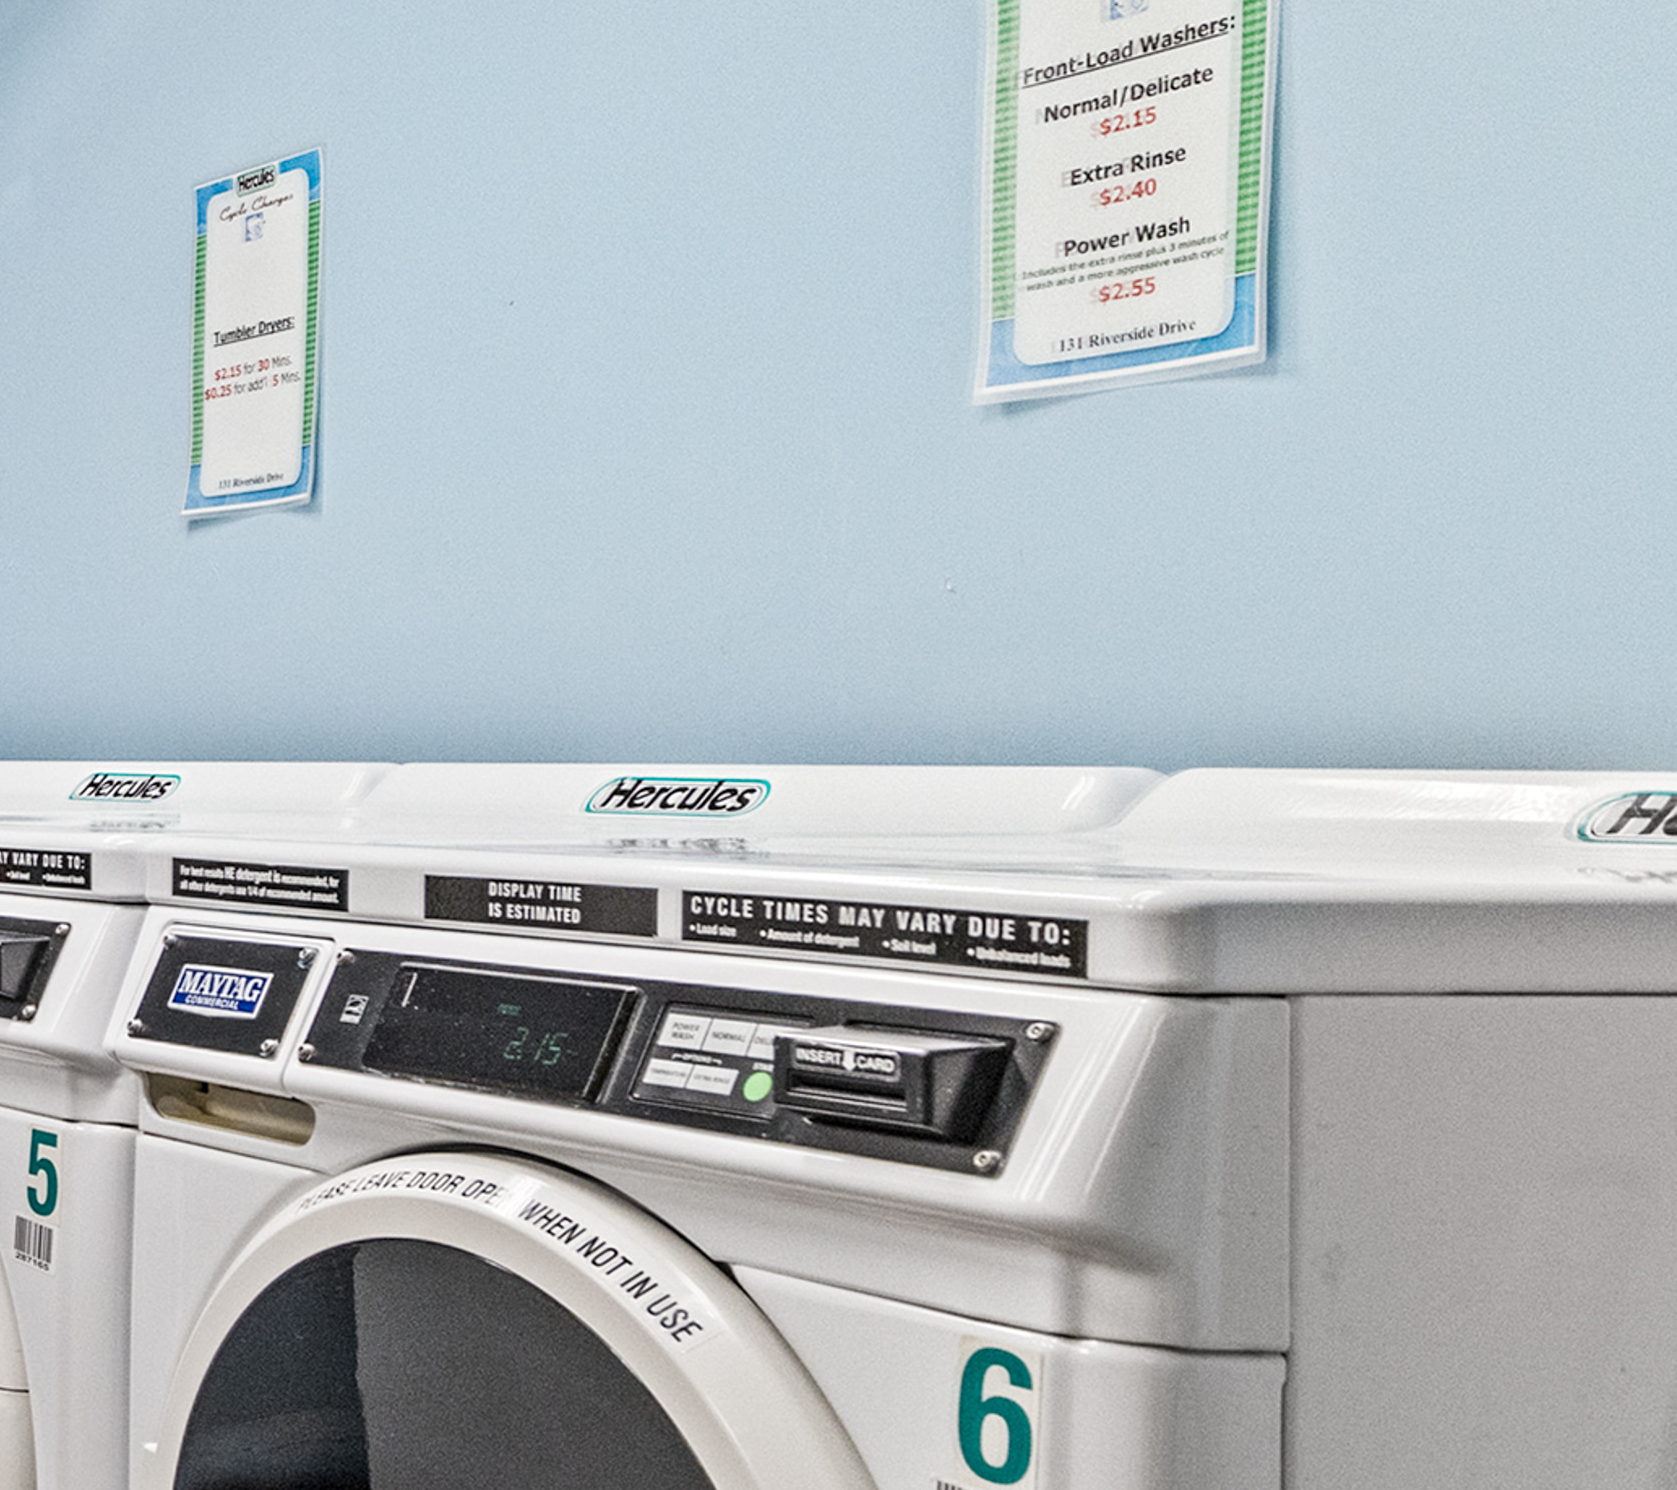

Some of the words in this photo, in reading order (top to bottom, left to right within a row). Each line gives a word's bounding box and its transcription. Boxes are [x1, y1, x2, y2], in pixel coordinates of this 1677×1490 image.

[1024, 40, 1133, 86] Front-Load
[1140, 15, 1236, 56] Washers:
[1043, 66, 1214, 123] Normal/Delicate
[1099, 107, 1157, 136] $2.15
[238, 168, 275, 192] Hercules
[1070, 158, 1123, 186] Extra
[1130, 145, 1186, 175] Rinse
[1099, 179, 1157, 207] $2.40
[219, 206, 248, 223] Cycle
[252, 194, 294, 212] Charges
[1064, 229, 1129, 257] Power
[1136, 217, 1190, 243] Wash
[1098, 278, 1156, 305] $2.55
[214, 324, 256, 345] Tumbler
[258, 317, 296, 338] Dryers:
[1059, 333, 1086, 352] 131
[1088, 323, 1155, 347] Riverside
[1160, 317, 1196, 338] Drive
[214, 364, 242, 381] $2.15
[244, 362, 256, 375] for
[257, 359, 270, 372] 30
[272, 355, 293, 368] Mins.
[205, 384, 232, 401] $0.25
[234, 381, 247, 395] for
[281, 371, 301, 385] Mins.
[79, 775, 173, 800] Hercules
[603, 780, 755, 812] Hercules
[489, 881, 537, 901] DISPLAY
[542, 885, 582, 902] TIME
[489, 903, 502, 919] IS
[506, 904, 581, 924] ESTIMATED
[691, 896, 753, 919] CYCLE
[764, 901, 828, 924] TIMES
[839, 905, 885, 929] MAY
[896, 911, 955, 935] VARY
[968, 917, 1015, 941] DUE
[1029, 922, 1071, 946] TO:
[179, 970, 266, 1002] MAYTAG
[185, 994, 239, 1010] COMMERCIAL
[796, 1047, 841, 1065] INSERT
[857, 1053, 894, 1073] CARD
[26, 1129, 59, 1216] 5
[352, 1172, 404, 1193] LEAVE
[407, 1171, 465, 1191] DOOR
[15, 1251, 50, 1273] 287165
[519, 1200, 582, 1244] WHEN
[577, 1234, 632, 1275] NOT
[620, 1270, 658, 1300] IN
[646, 1292, 704, 1343] USE
[956, 1346, 1034, 1485] 6
